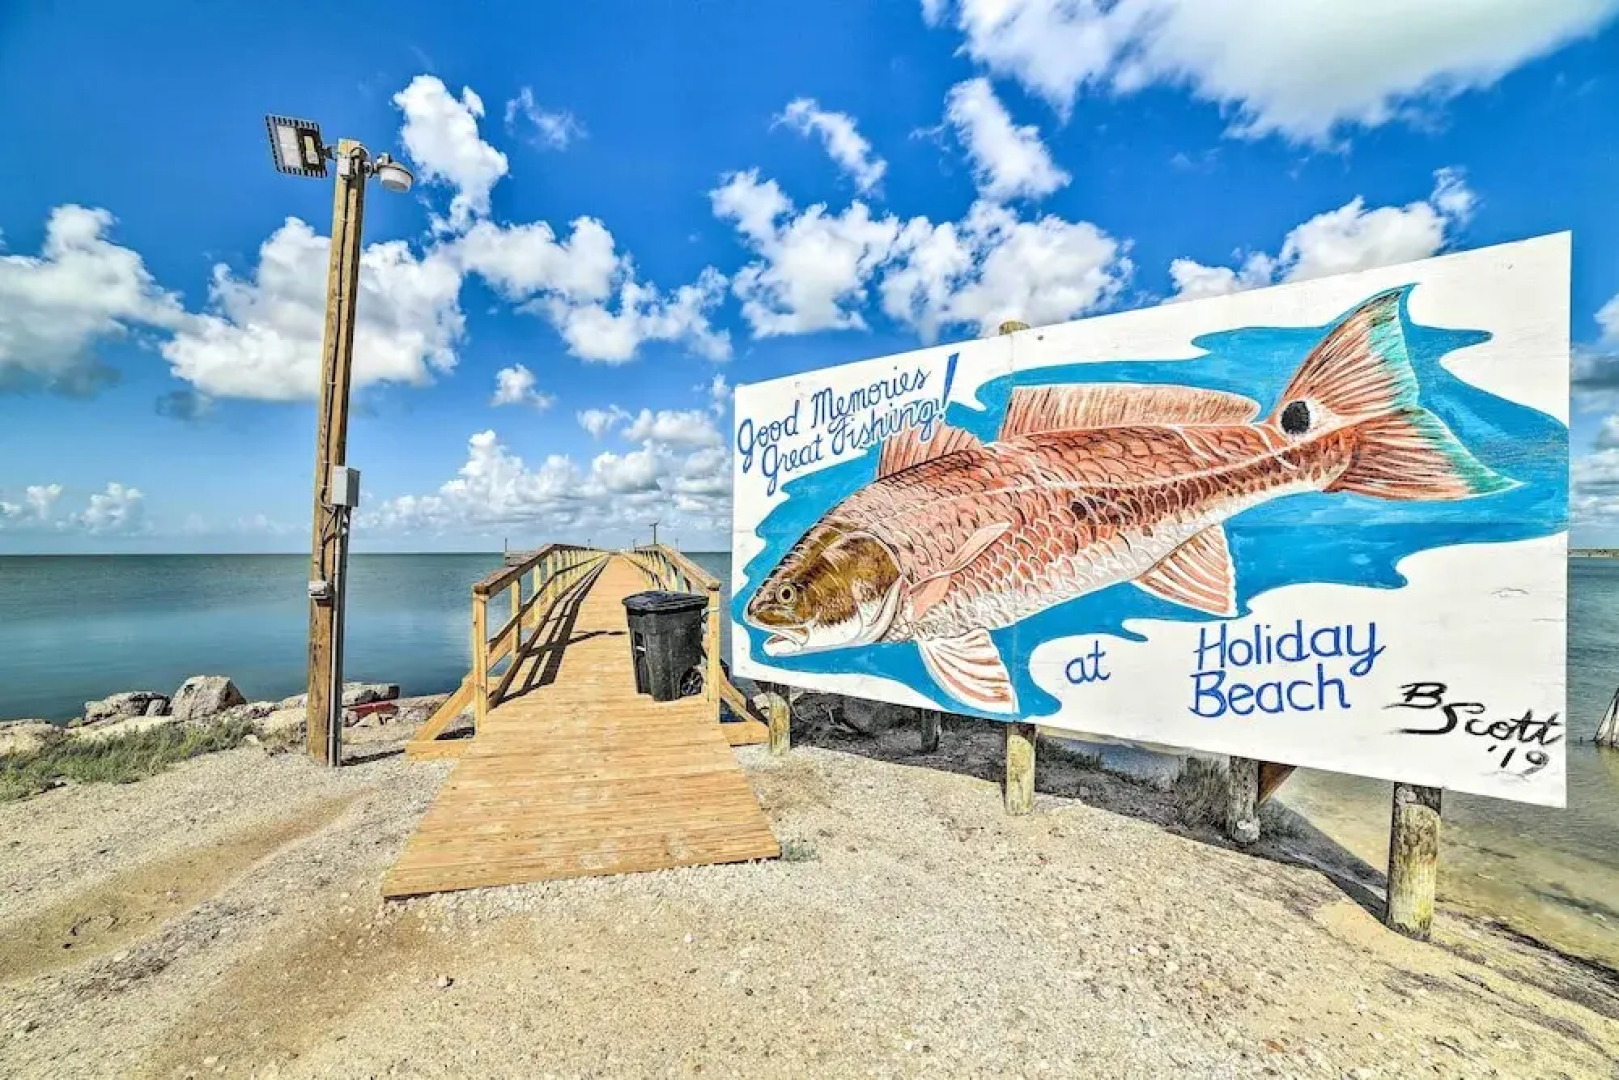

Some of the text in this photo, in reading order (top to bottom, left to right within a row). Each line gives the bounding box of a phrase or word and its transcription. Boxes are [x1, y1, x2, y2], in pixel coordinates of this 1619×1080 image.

[737, 366, 931, 474] Good Memories
[761, 352, 960, 497] Great Fishing!
[1065, 640, 1110, 684] at
[1193, 619, 1386, 677] Holiday
[1188, 663, 1350, 718] Beach
[1382, 682, 1448, 710] B
[1384, 702, 1562, 745] Scott
[1487, 745, 1549, 775] '19
